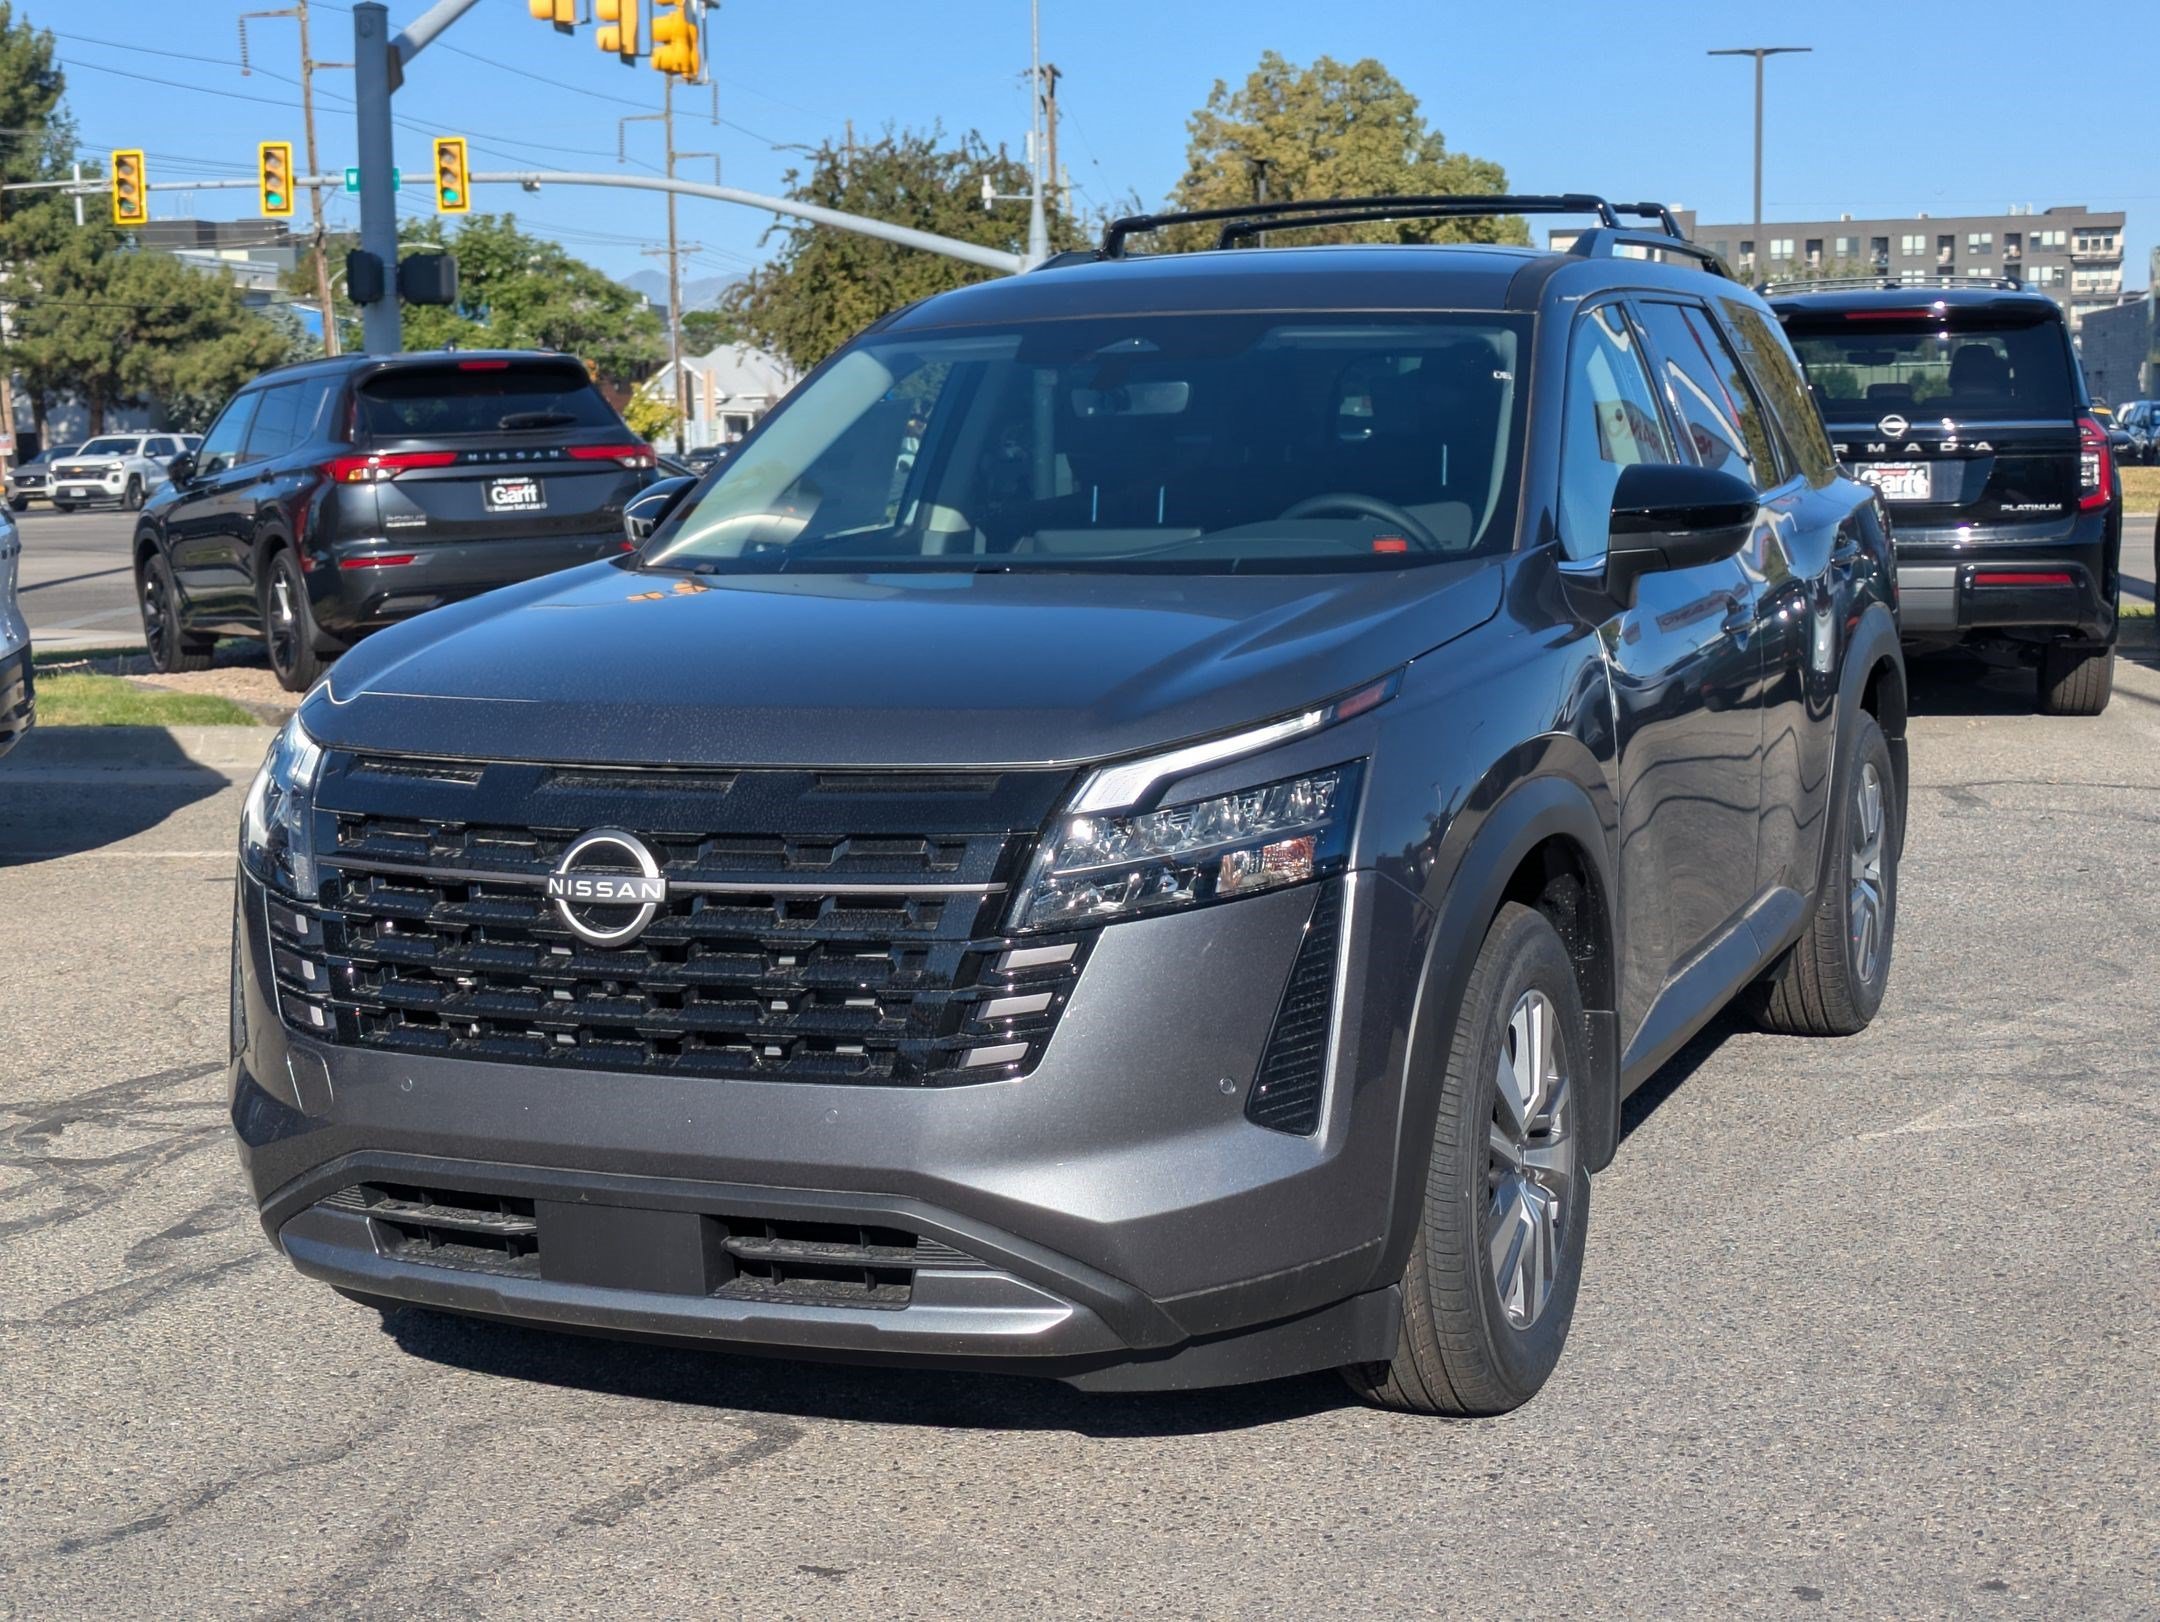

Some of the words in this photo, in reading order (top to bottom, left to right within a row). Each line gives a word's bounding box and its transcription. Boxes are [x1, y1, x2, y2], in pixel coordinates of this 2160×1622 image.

[1832, 442, 1993, 453] RMADA
[467, 450, 559, 461] NISSAN
[491, 484, 537, 505] Garff
[2000, 503, 2063, 512] PLATINUM
[548, 878, 661, 899] NISSAN
